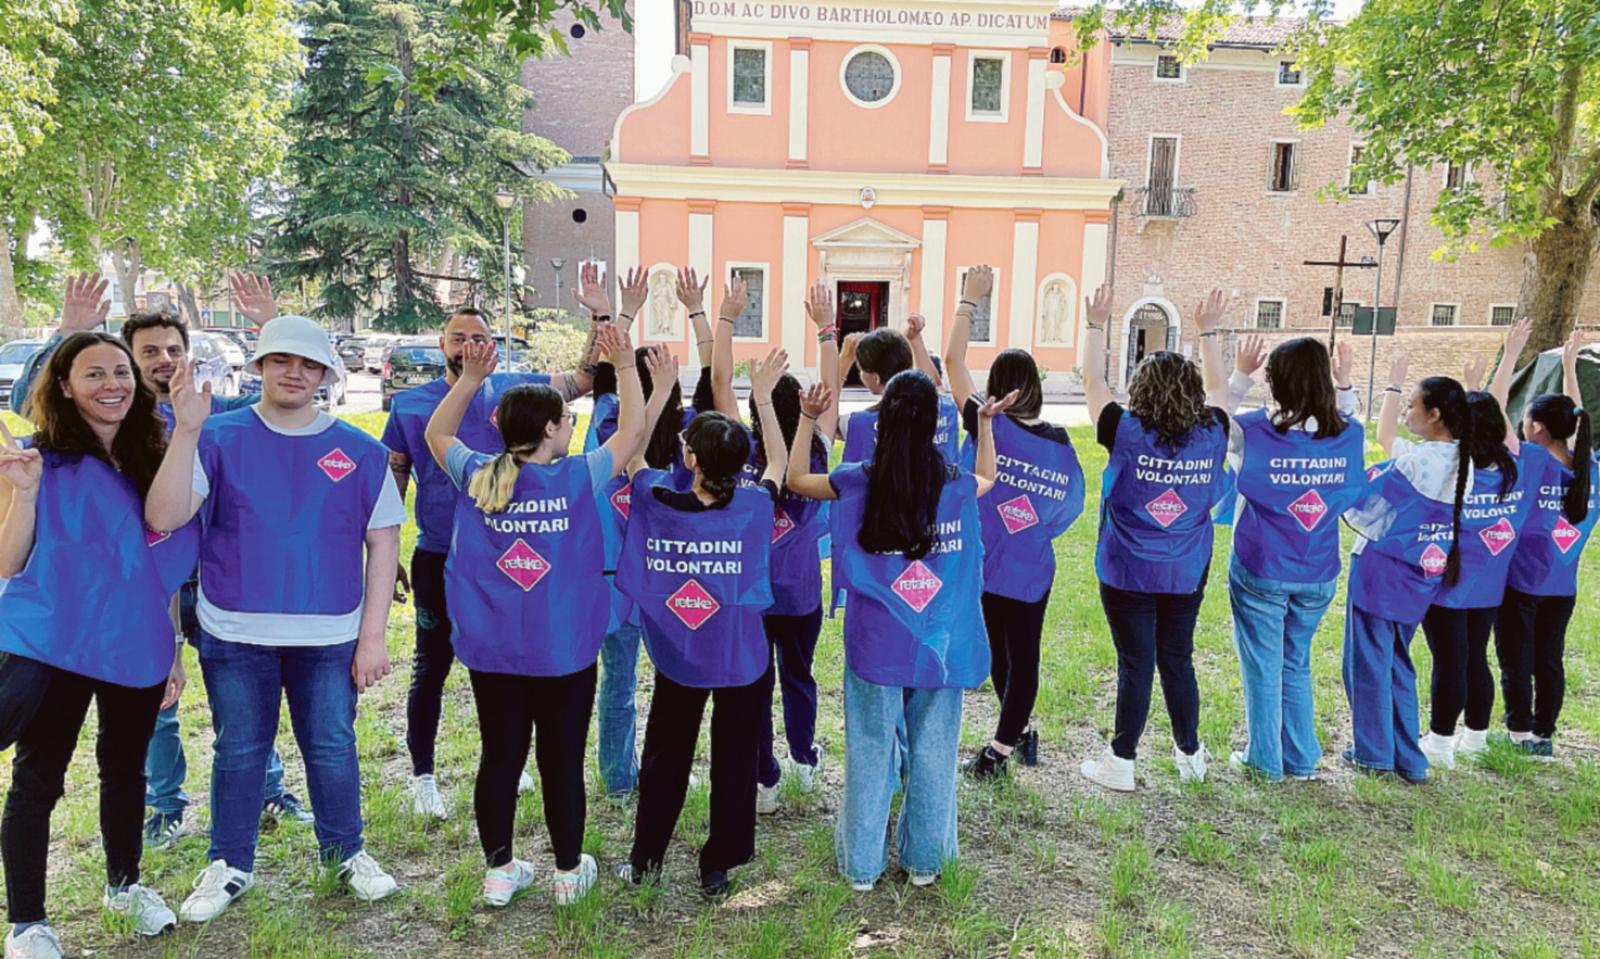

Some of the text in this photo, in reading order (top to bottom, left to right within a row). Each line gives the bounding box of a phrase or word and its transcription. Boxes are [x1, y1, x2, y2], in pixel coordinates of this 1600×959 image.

[742, 2, 764, 18] AC
[770, 4, 810, 20] DIVO
[816, 7, 944, 26] BARTHOLOMÆO
[977, 13, 1048, 30] DICATUM
[996, 454, 1070, 486] CITTADINI
[1137, 454, 1214, 471] CITTADINI
[1269, 456, 1348, 470] CITTADINI
[1136, 468, 1212, 486] VOLONTARI
[1269, 473, 1346, 486] VOLONTARI
[506, 497, 569, 514] TADINI
[484, 514, 570, 534] LONTARI
[646, 537, 743, 555] CITTADINI
[646, 555, 743, 575] VOLONTARI
